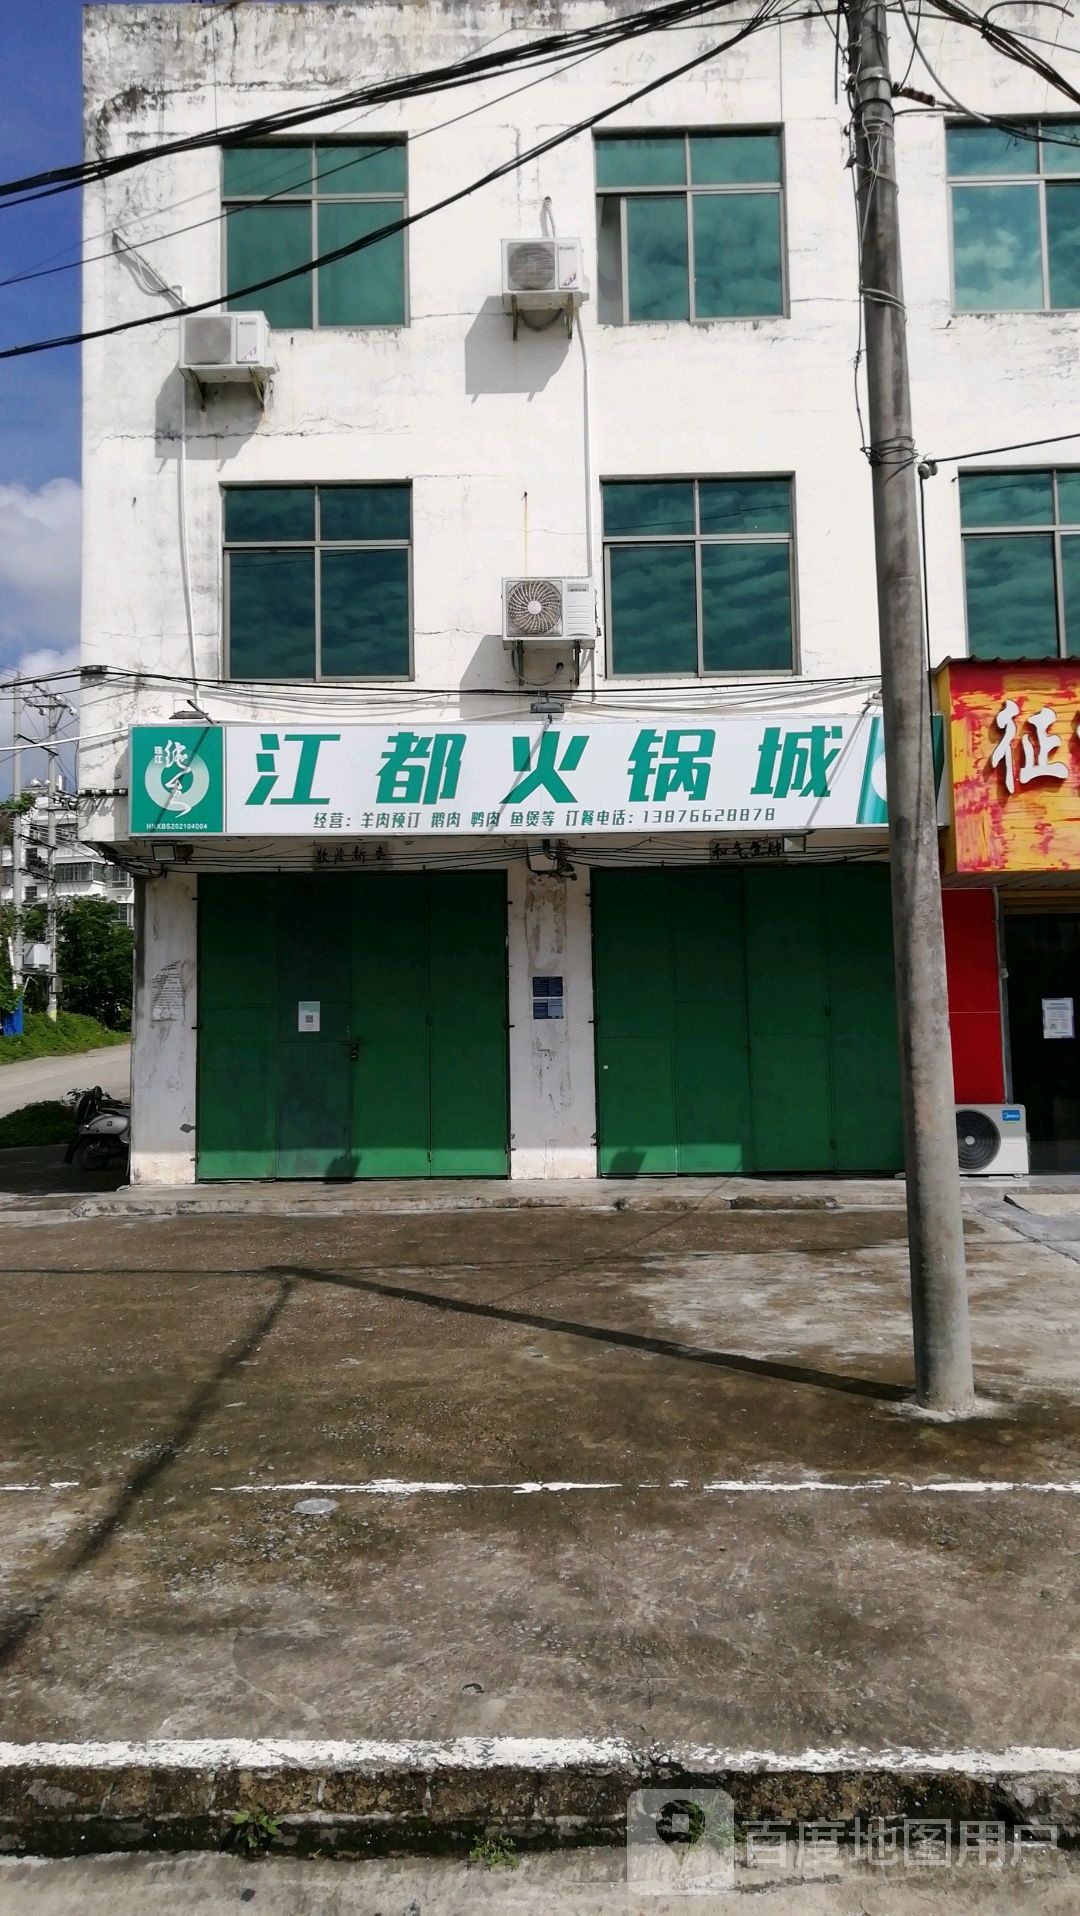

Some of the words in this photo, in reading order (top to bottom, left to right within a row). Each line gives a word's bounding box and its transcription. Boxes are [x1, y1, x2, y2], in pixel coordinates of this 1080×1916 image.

[244, 725, 843, 806] 江都火锅城
[991, 699, 1080, 794] 征
[430, 811, 461, 828] 鹅肉
[471, 811, 500, 828] 鸭肉
[510, 810, 555, 827] 鱼煲等
